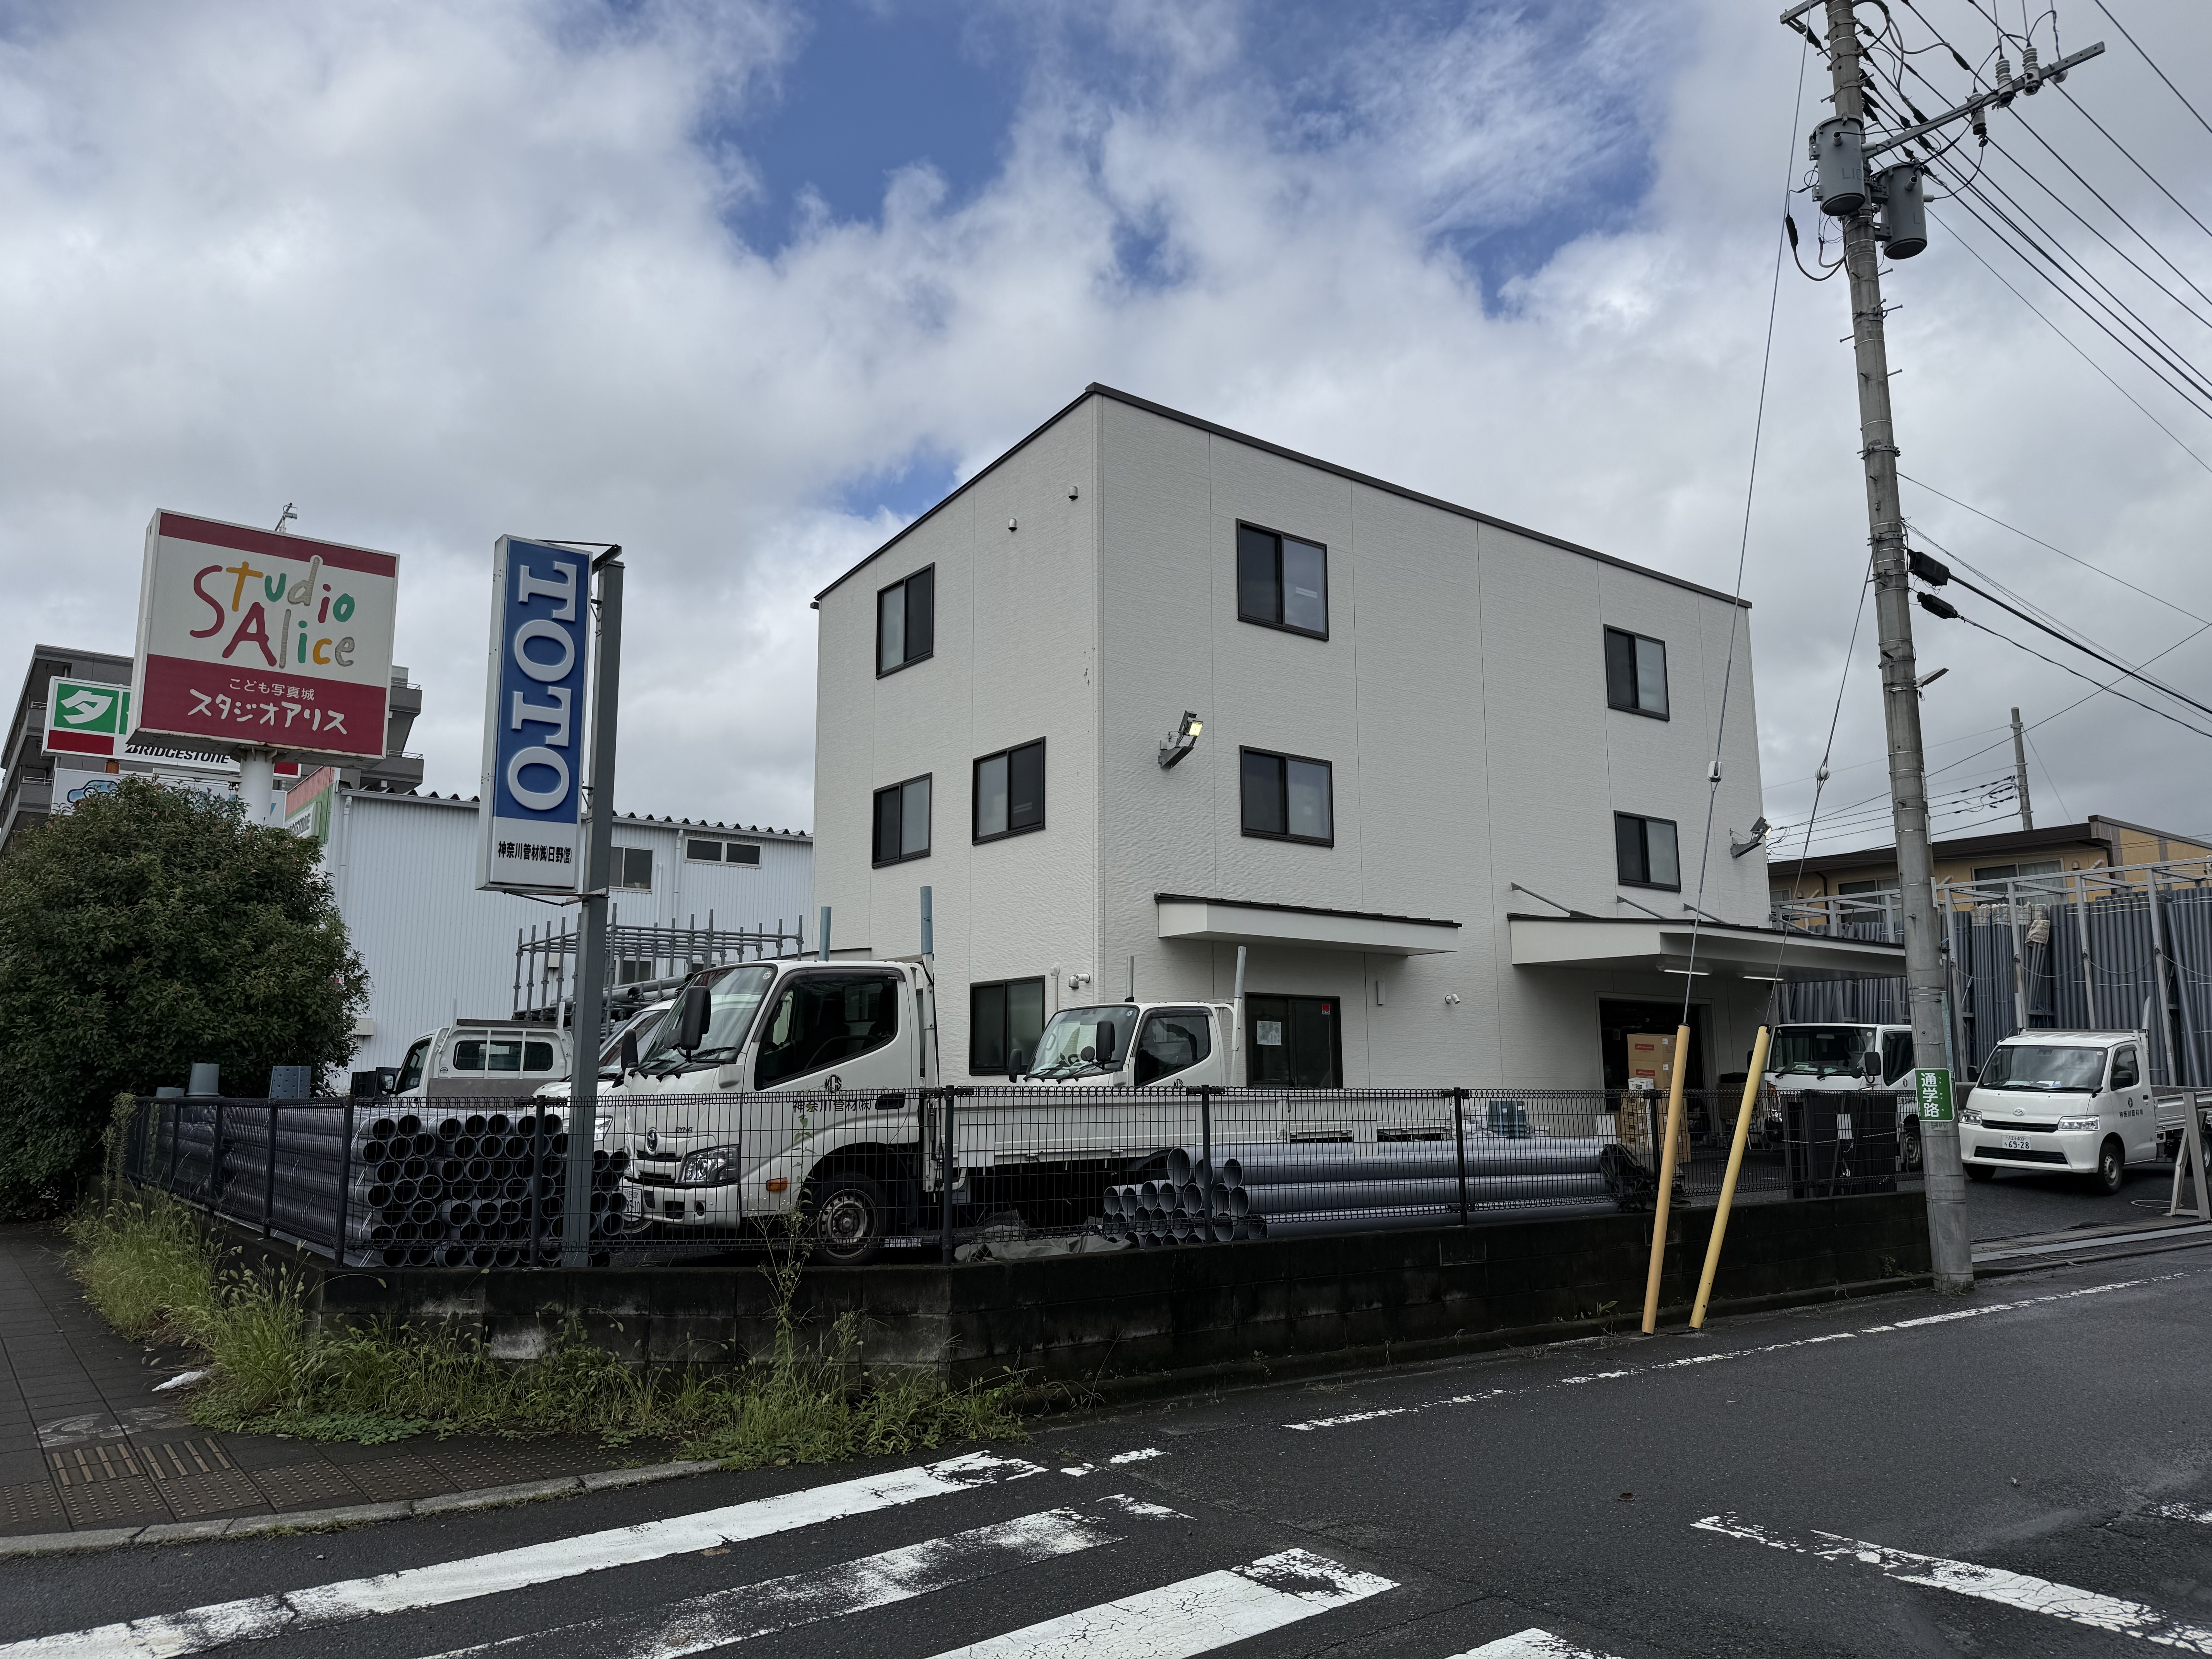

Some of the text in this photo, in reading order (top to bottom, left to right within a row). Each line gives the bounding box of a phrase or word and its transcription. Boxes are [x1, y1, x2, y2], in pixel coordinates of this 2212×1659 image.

[189, 557, 355, 638] Studio
[222, 601, 355, 669] Alice
[60, 690, 129, 724] タ
[230, 678, 315, 701] こども写真城
[507, 561, 577, 810] TOTO
[187, 689, 347, 735] スタジオアリス
[124, 744, 230, 764] BRIDGESTONE
[1921, 1072, 1940, 1118] 通学路
[2009, 1141, 2029, 1149] 69-28
